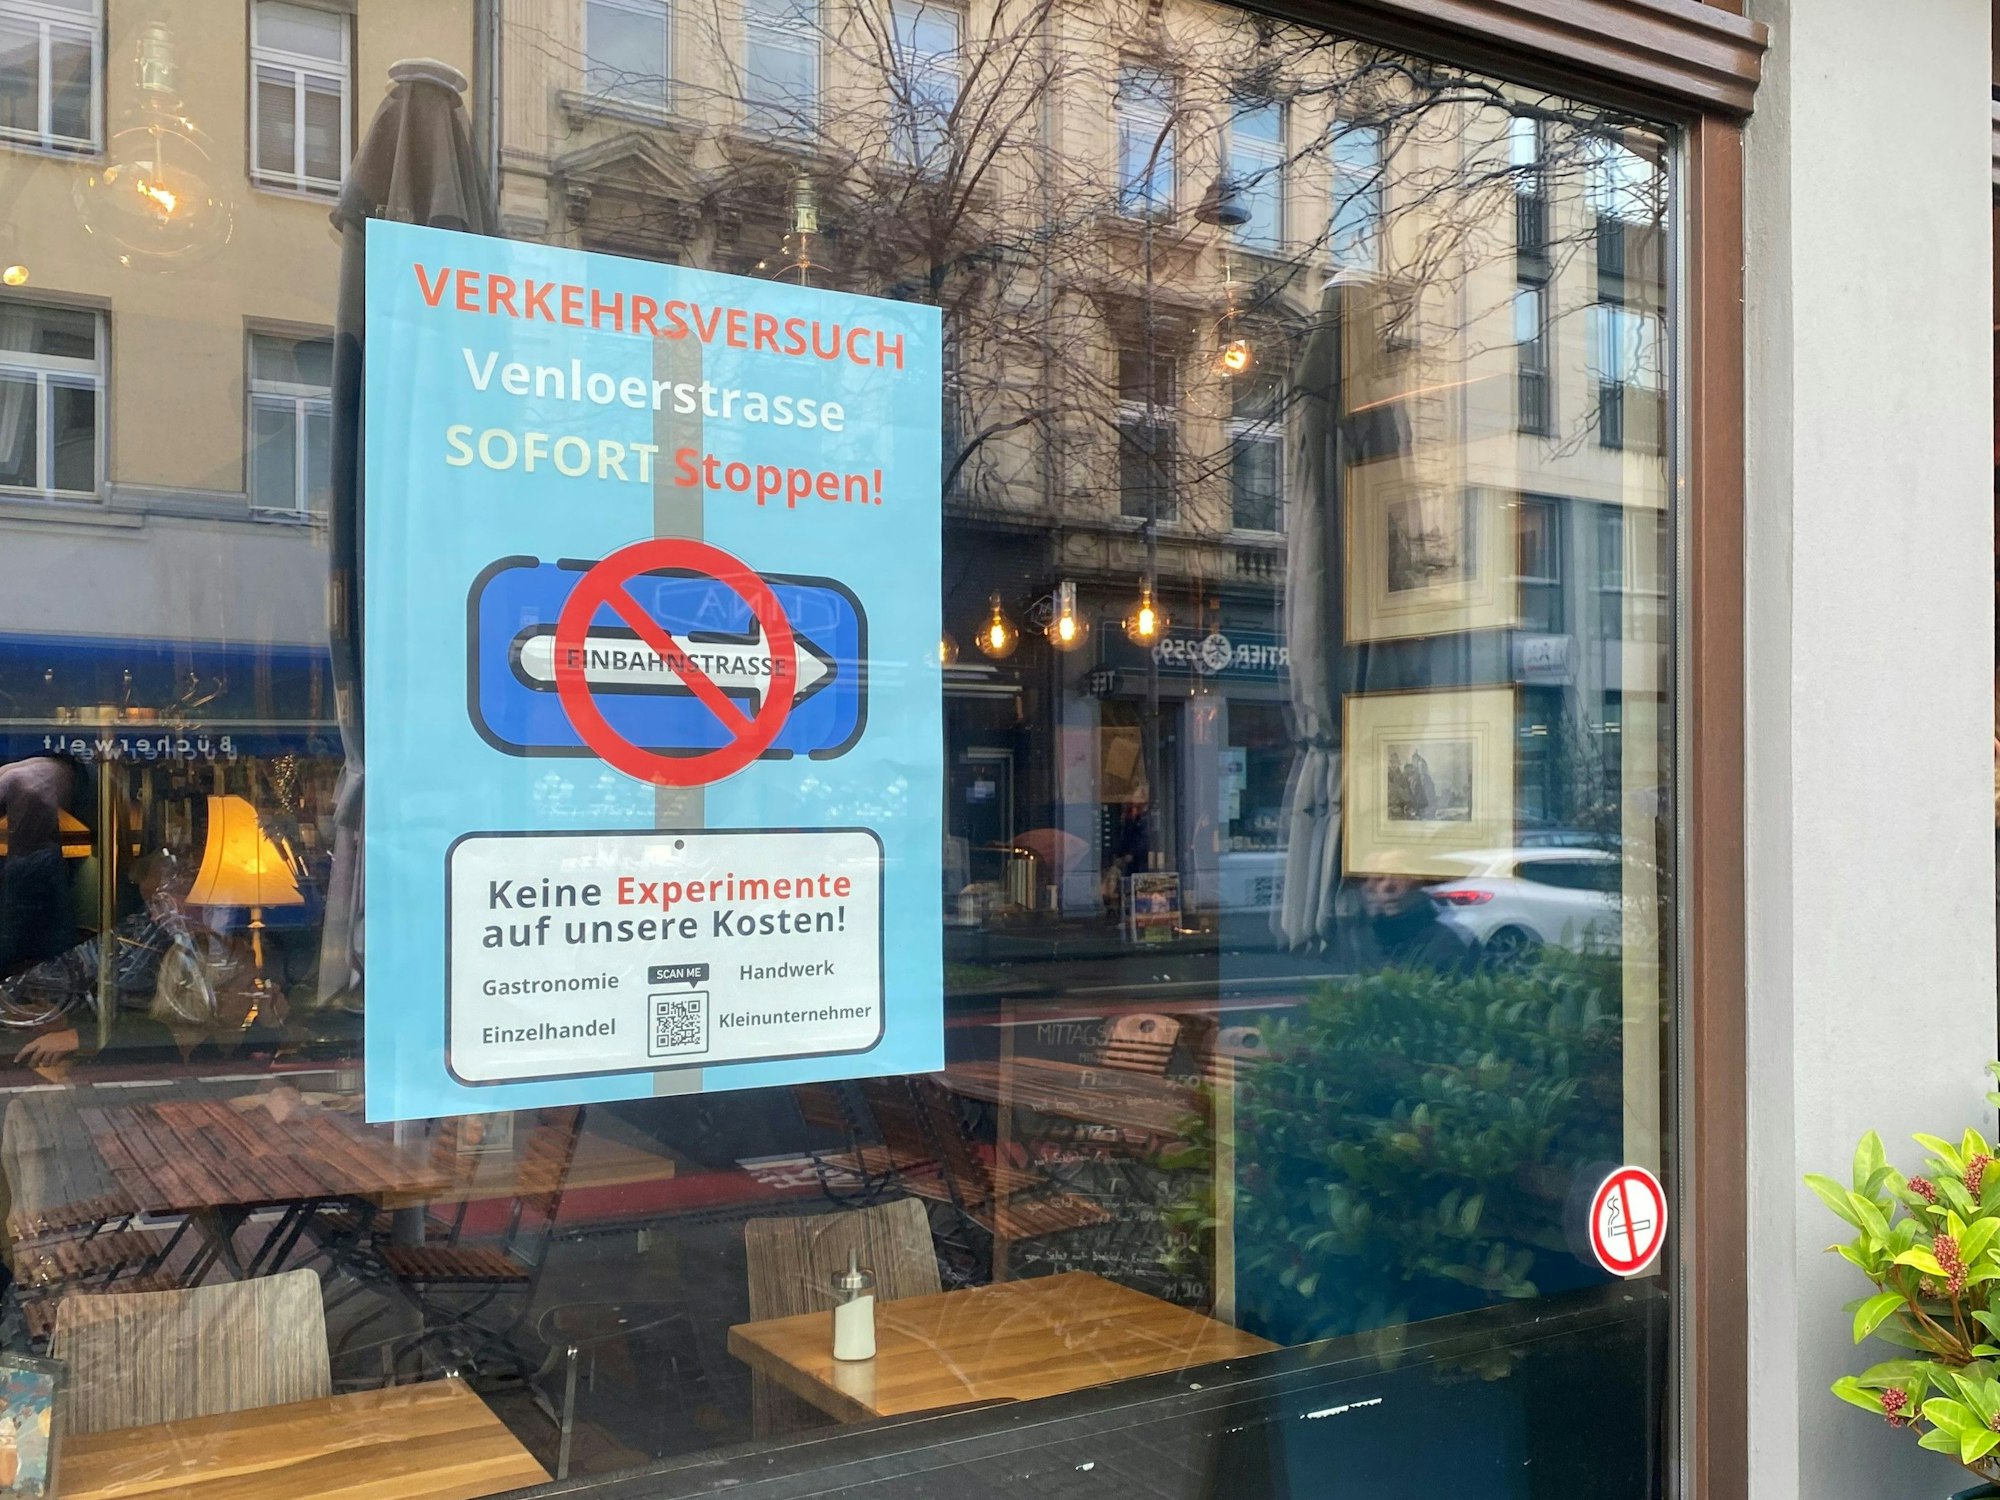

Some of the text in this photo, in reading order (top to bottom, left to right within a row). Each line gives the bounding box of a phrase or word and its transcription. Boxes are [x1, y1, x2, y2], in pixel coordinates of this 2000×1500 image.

[414, 263, 904, 369] VERKEHRSVERSUCH
[462, 346, 845, 432] Venloerstrasse
[445, 424, 883, 508] SOFORT Stoppen!
[567, 649, 787, 677] EINBAHNSTRASSE
[488, 872, 852, 912] Keine Experimente
[482, 906, 846, 948] auf unsere Kosten!
[482, 972, 619, 996] Gastronomie
[656, 966, 702, 980] SCAN ME
[739, 960, 835, 981] Handwerk
[719, 1004, 872, 1029] Kleinunternehmer
[482, 1018, 616, 1044] Einzelhandel
